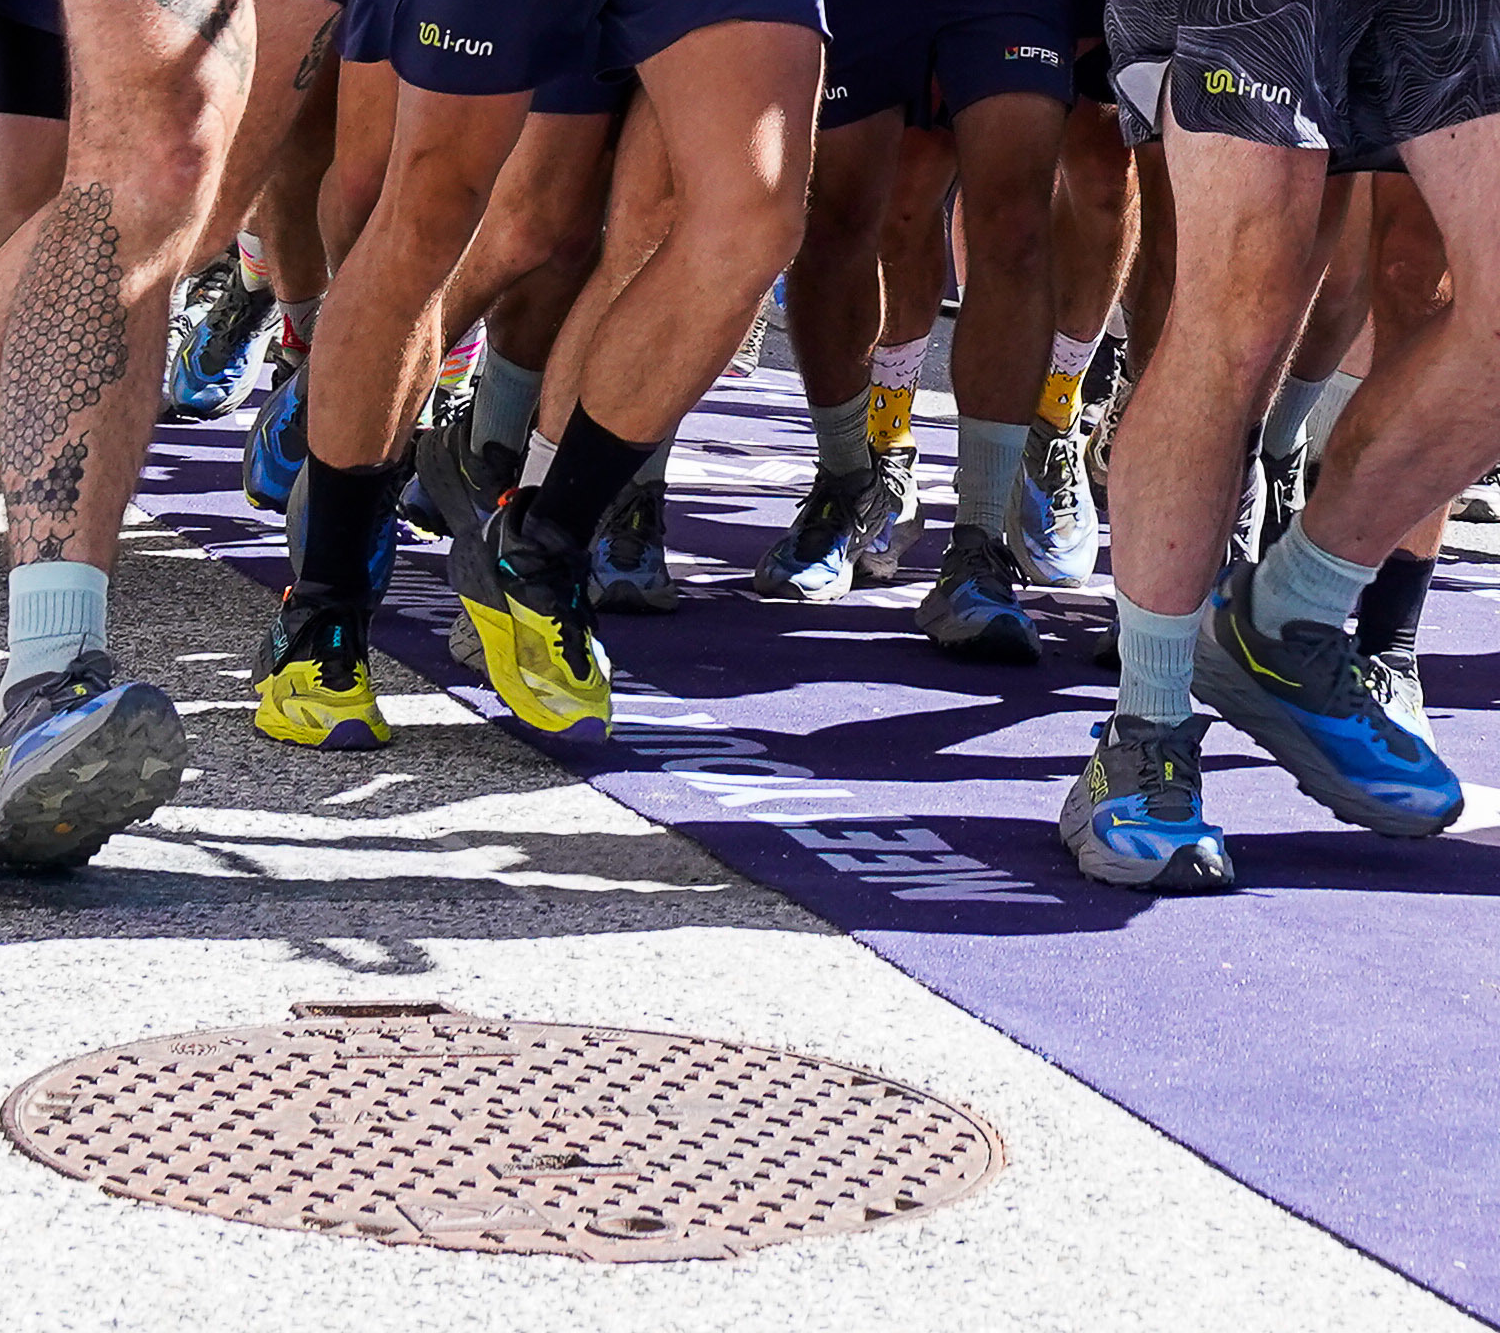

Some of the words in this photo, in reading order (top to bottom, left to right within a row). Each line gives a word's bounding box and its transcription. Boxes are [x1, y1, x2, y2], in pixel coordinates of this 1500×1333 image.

[442, 29, 494, 57] i-run
[1020, 46, 1060, 64] OFPS
[1239, 73, 1292, 106] i-run
